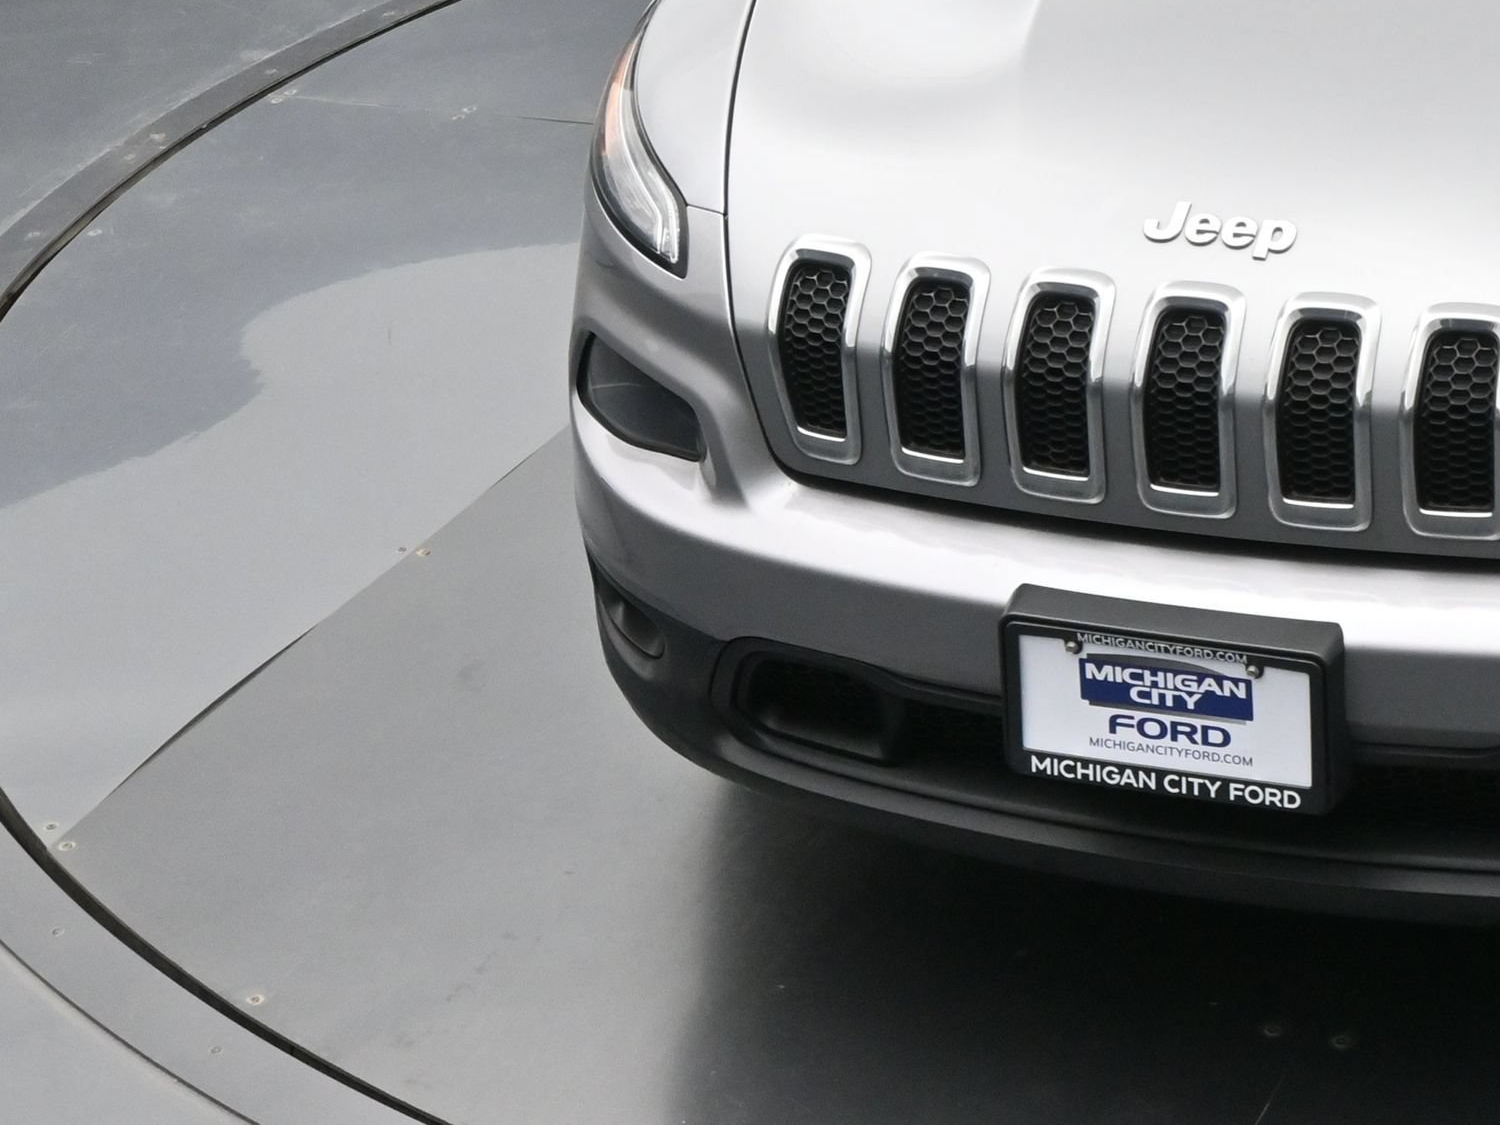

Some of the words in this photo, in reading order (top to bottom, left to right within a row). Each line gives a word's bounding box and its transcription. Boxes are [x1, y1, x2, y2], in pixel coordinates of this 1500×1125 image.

[1143, 201, 1297, 261] Jeep
[1077, 633, 1248, 664] MICHIGANCITYFORD.COM
[1085, 663, 1247, 699] MICHIGAN
[1130, 686, 1203, 710] CITY
[1109, 714, 1231, 748] FORD
[1089, 736, 1253, 767] MICHIGANCITYFORD.COM
[1032, 755, 1156, 790] MICHIGAN
[1165, 775, 1222, 798] CITY
[1230, 783, 1301, 809] FORD
